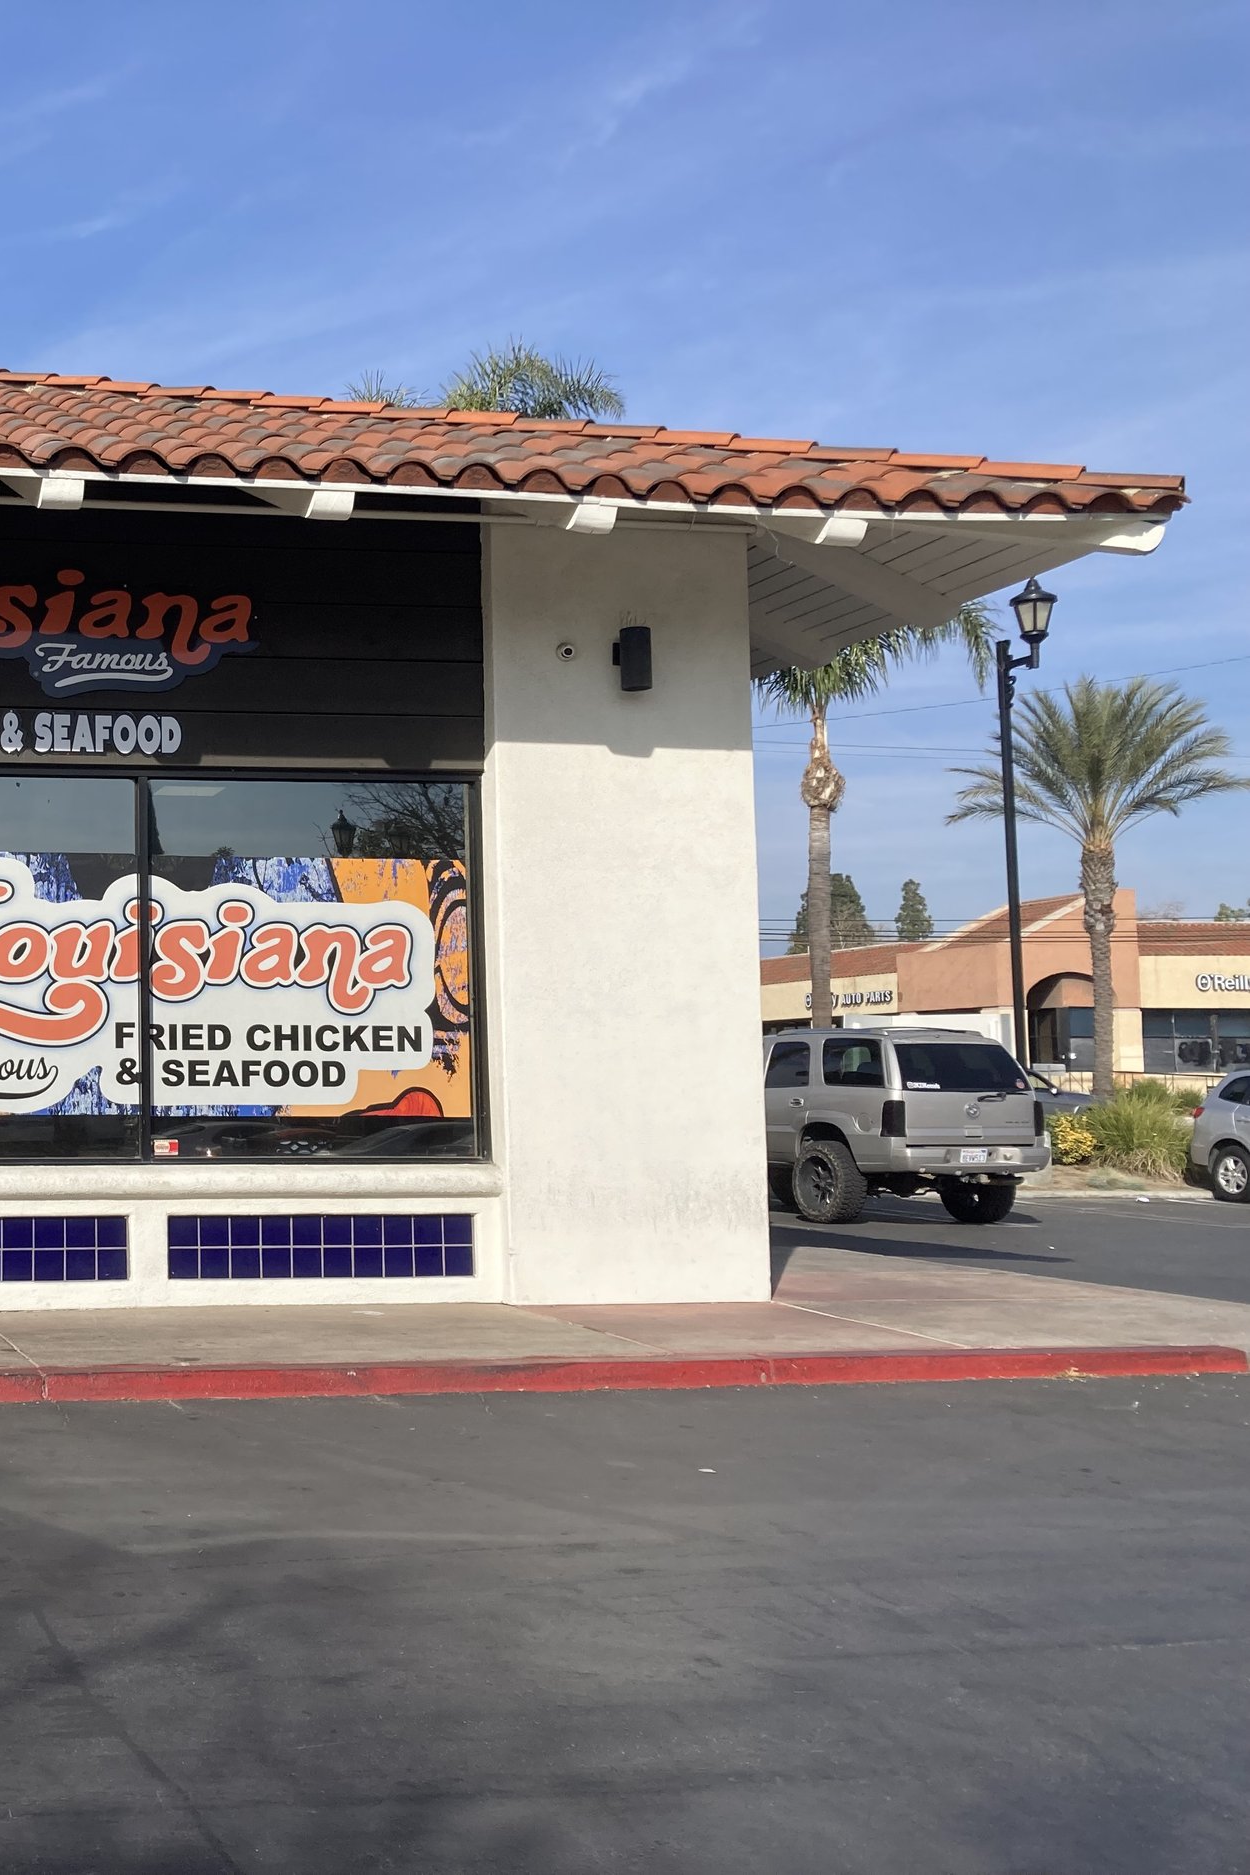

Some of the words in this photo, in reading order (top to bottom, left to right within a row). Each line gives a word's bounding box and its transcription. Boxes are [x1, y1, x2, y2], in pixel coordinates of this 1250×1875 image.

[35, 643, 173, 688] Famous
[0, 711, 24, 751] &
[34, 712, 182, 754] SEAFOOD
[841, 992, 863, 1006] AUTO
[864, 990, 892, 1004] PARTS
[114, 1021, 232, 1051] FRIED
[246, 1024, 423, 1053] CHICKEN
[115, 1057, 143, 1086] &
[161, 1059, 347, 1088] SEAFOOD
